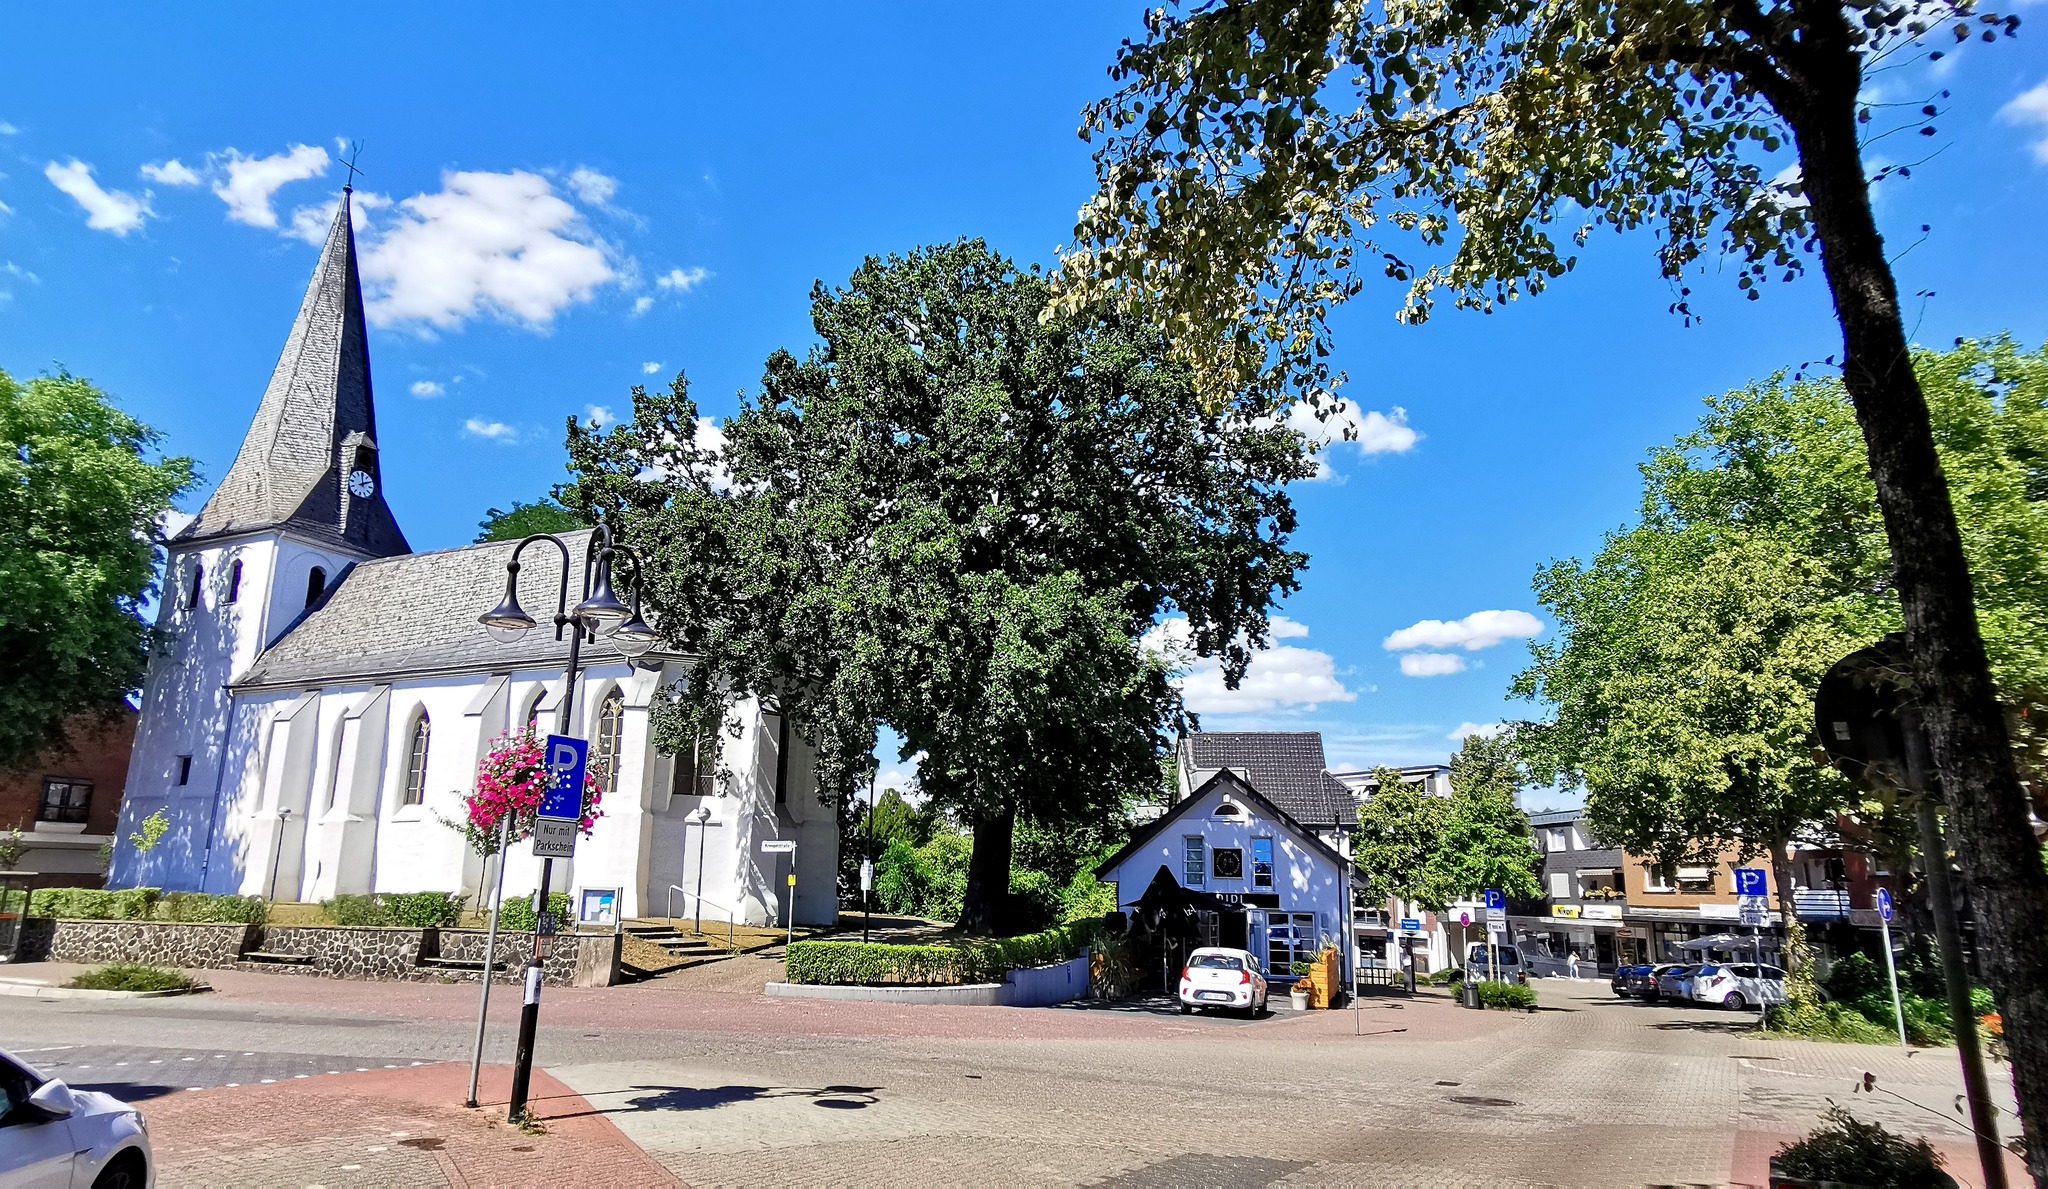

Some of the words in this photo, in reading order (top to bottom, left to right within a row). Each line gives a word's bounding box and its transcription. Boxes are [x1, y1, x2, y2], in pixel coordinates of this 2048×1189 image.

[550, 744, 578, 789] P
[543, 824, 556, 835] Nur
[558, 825, 570, 836] mit
[536, 839, 573, 852] Parkschein
[1742, 871, 1760, 893] P
[1489, 891, 1500, 907] P
